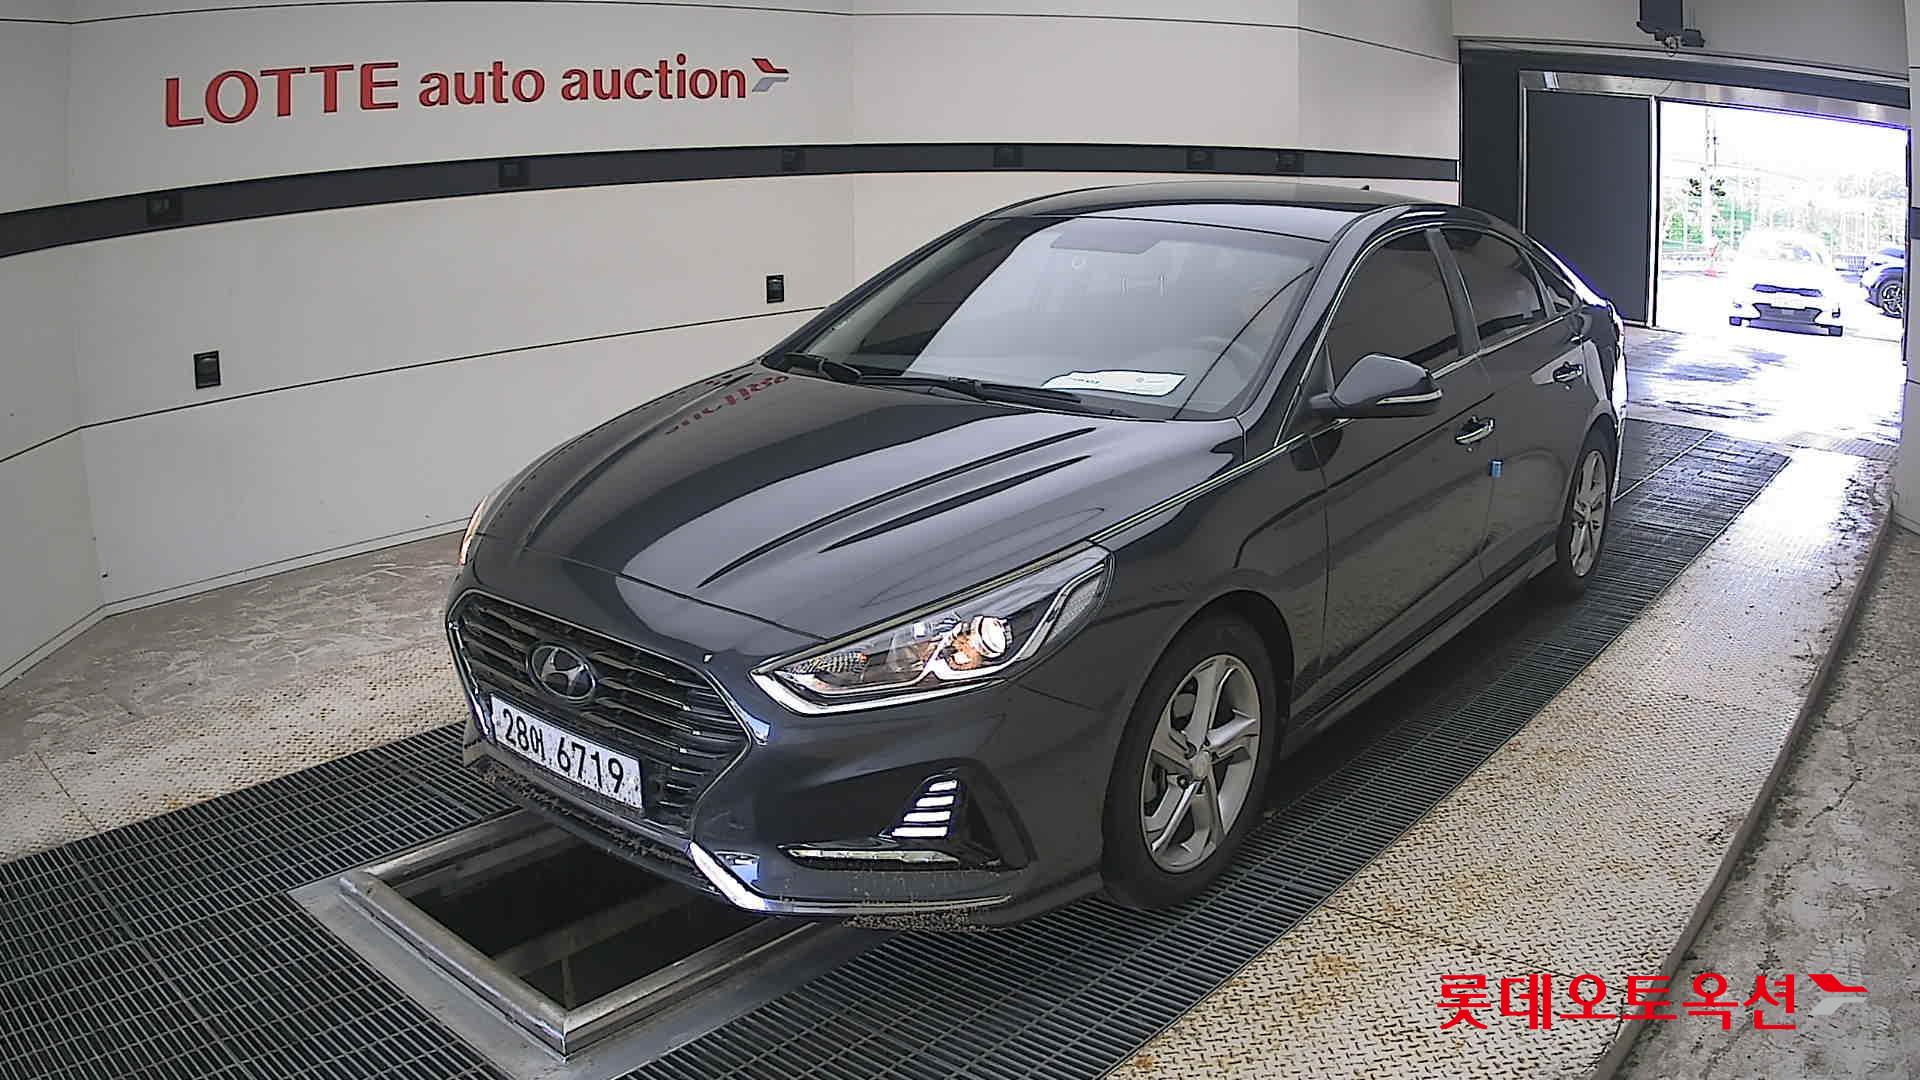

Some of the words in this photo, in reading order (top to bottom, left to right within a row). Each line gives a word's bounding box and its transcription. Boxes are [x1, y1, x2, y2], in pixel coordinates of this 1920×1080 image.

[165, 61, 399, 128] LOTTE
[418, 60, 545, 107] auto
[560, 53, 746, 101] auction
[503, 707, 546, 761] 28어
[557, 736, 625, 794] 6719
